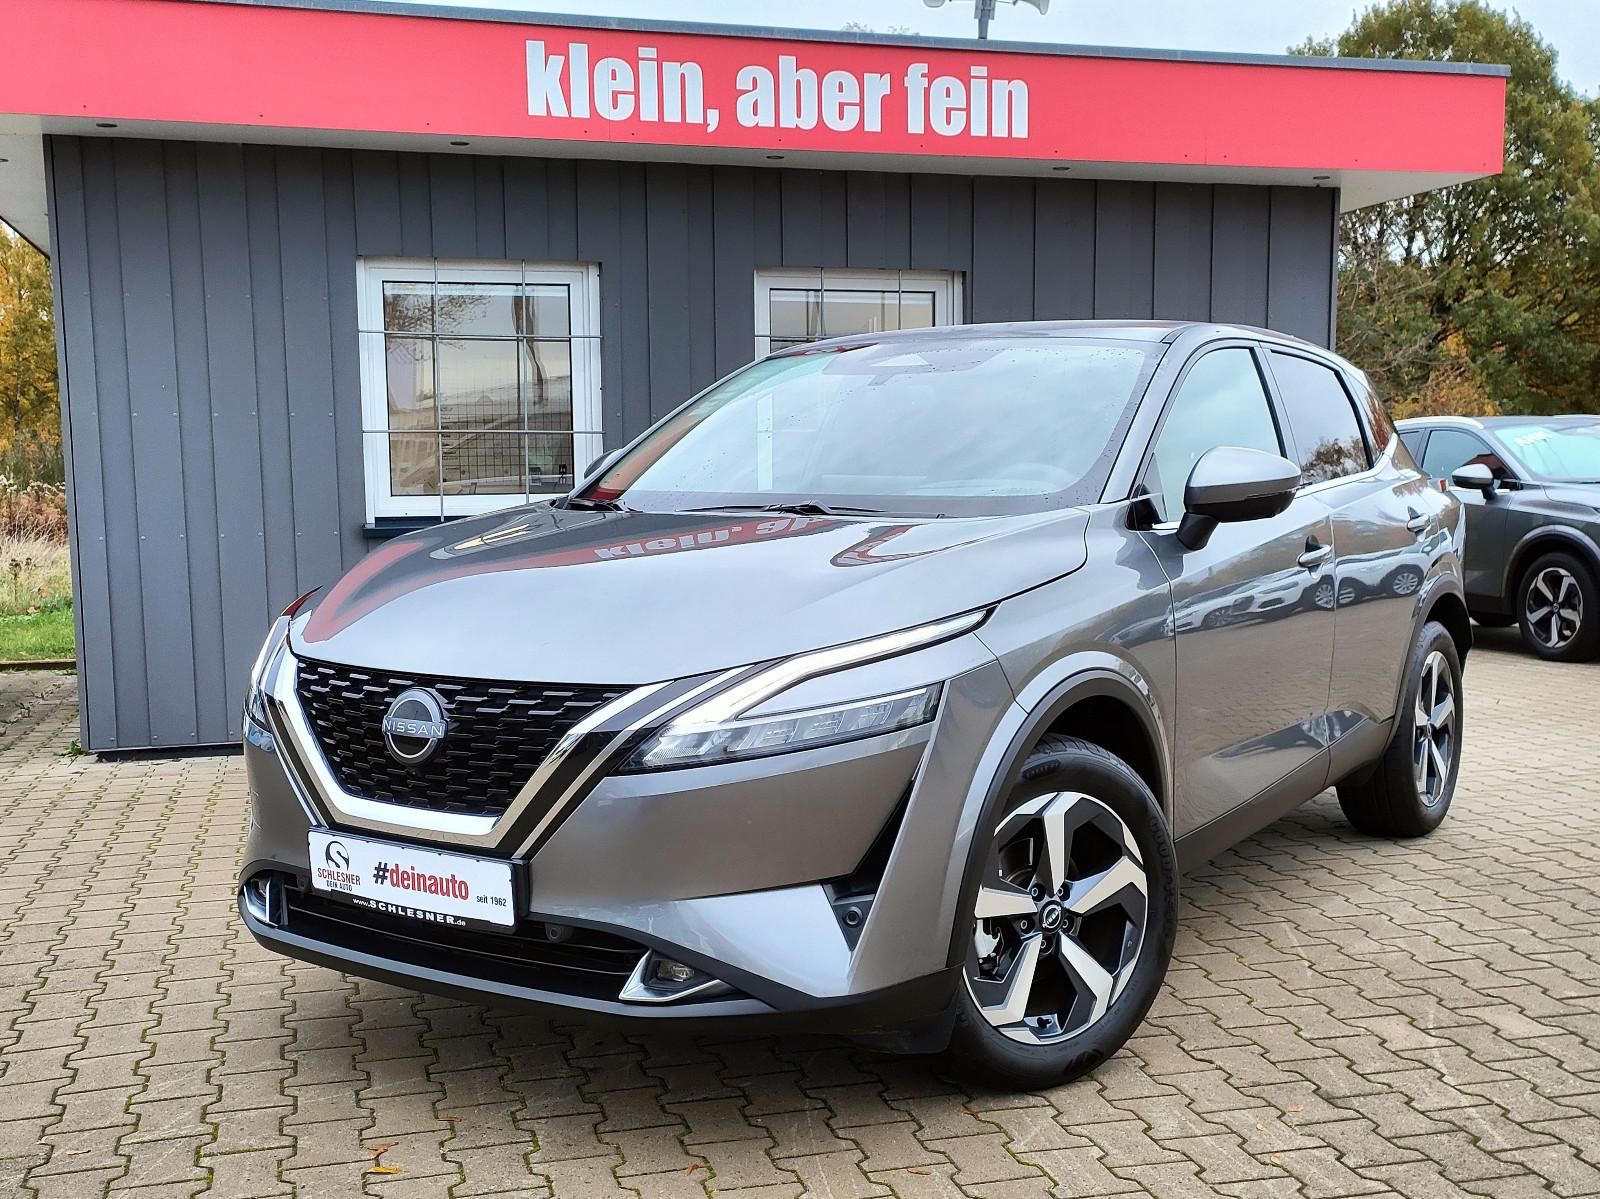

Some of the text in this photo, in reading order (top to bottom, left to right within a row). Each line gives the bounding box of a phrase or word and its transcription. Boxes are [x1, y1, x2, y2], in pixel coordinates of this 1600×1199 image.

[525, 39, 1029, 138] klein, aber fein
[384, 719, 443, 736] NISSAN
[317, 867, 361, 886] SCHLESNER
[373, 861, 469, 901] #deinauto
[476, 894, 507, 907] seit 1962
